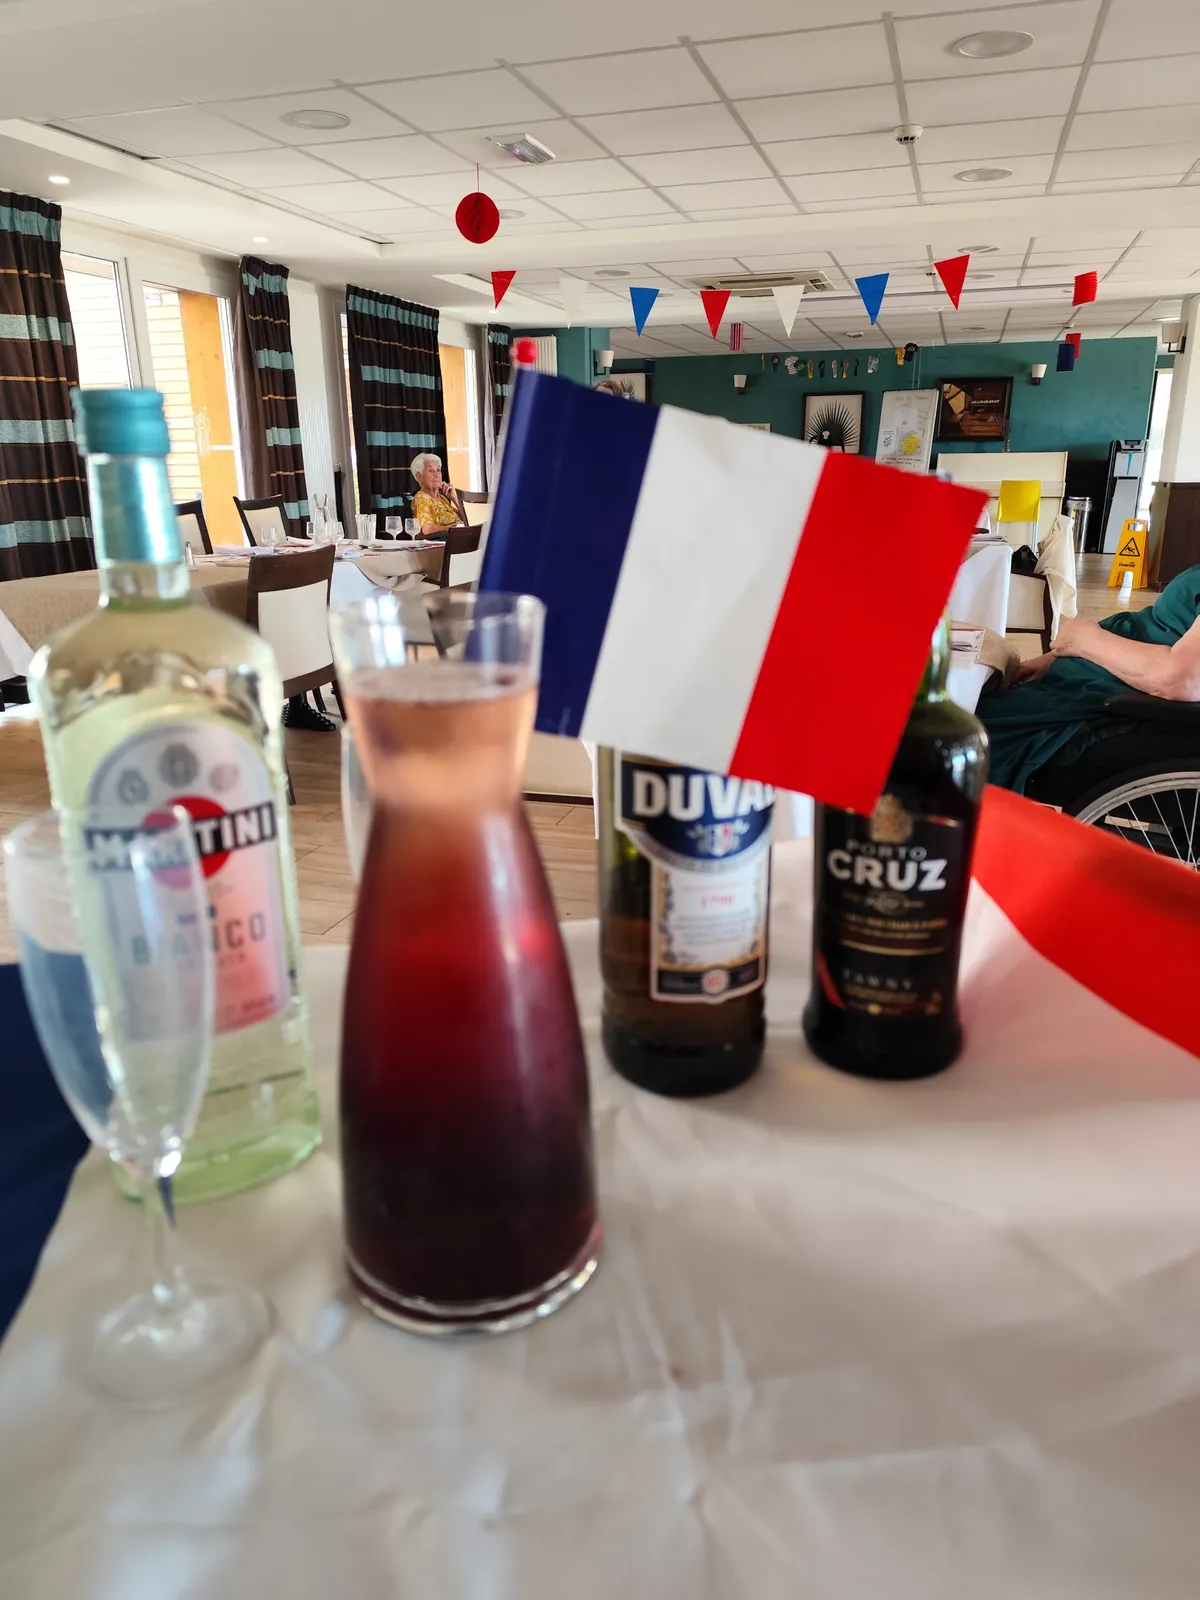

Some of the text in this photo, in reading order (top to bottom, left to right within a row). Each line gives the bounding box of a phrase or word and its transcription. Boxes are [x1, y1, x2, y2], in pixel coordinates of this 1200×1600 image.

[92, 806, 275, 867] MTINI
[846, 839, 928, 862] PORTO
[827, 848, 948, 892] CRUZ
[132, 912, 267, 965] BACO
